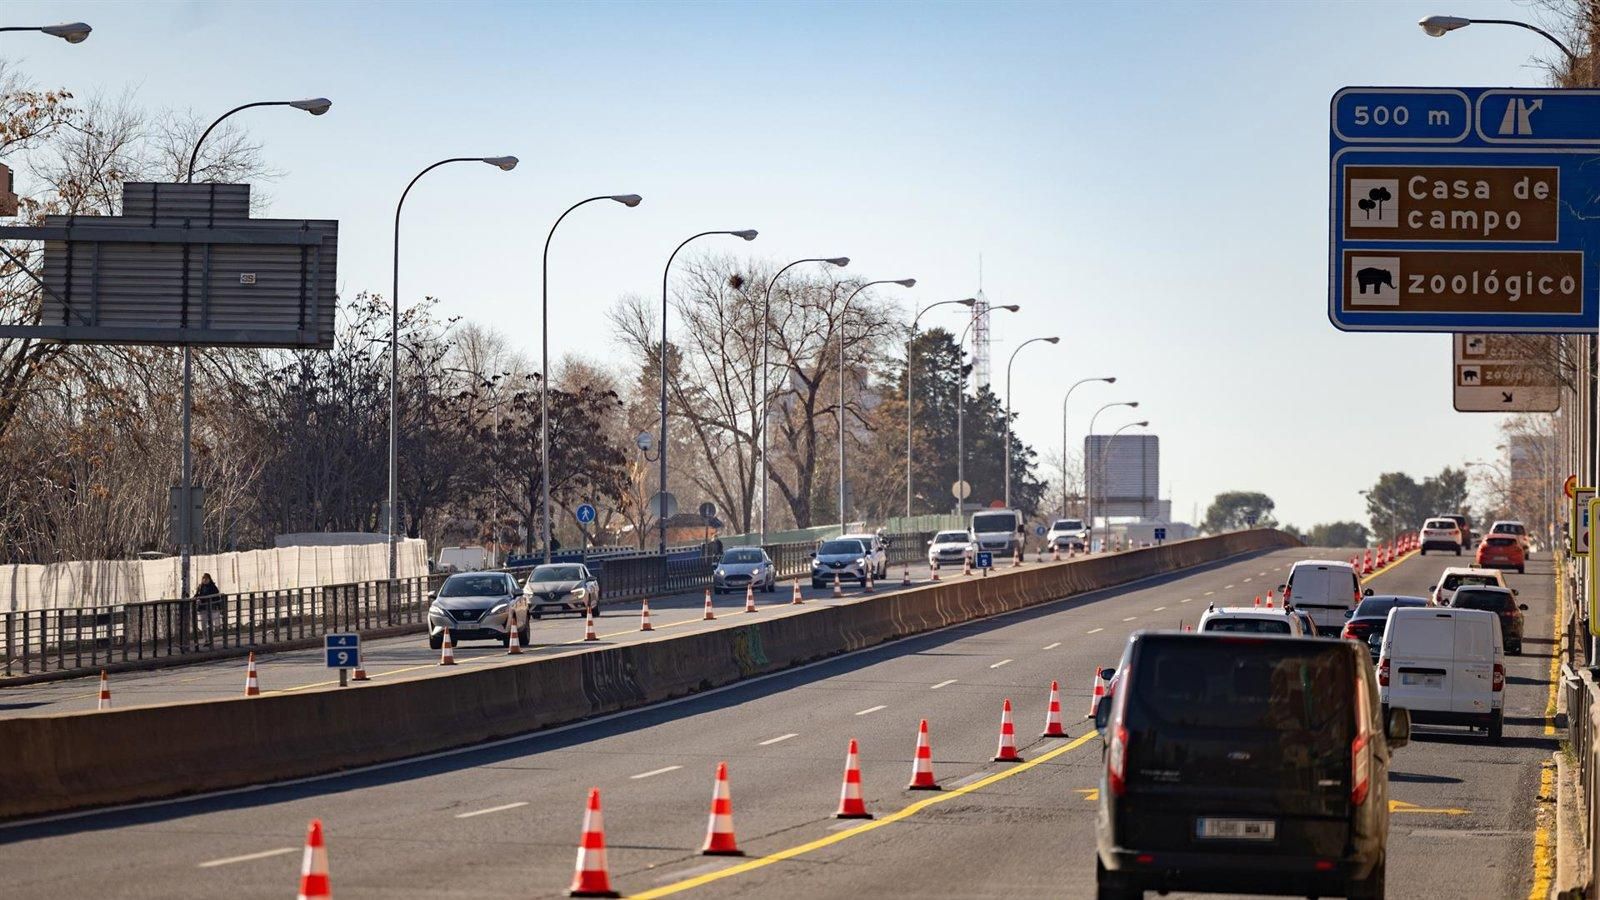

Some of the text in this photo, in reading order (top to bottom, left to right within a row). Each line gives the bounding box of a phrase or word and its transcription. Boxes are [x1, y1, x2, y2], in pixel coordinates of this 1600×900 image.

[1354, 105, 1450, 126] 500 m
[1408, 175, 1550, 200] Casa de
[1407, 209, 1522, 237] campo
[1408, 269, 1576, 302] zoológico
[338, 637, 346, 645] 4
[337, 651, 349, 665] 9
